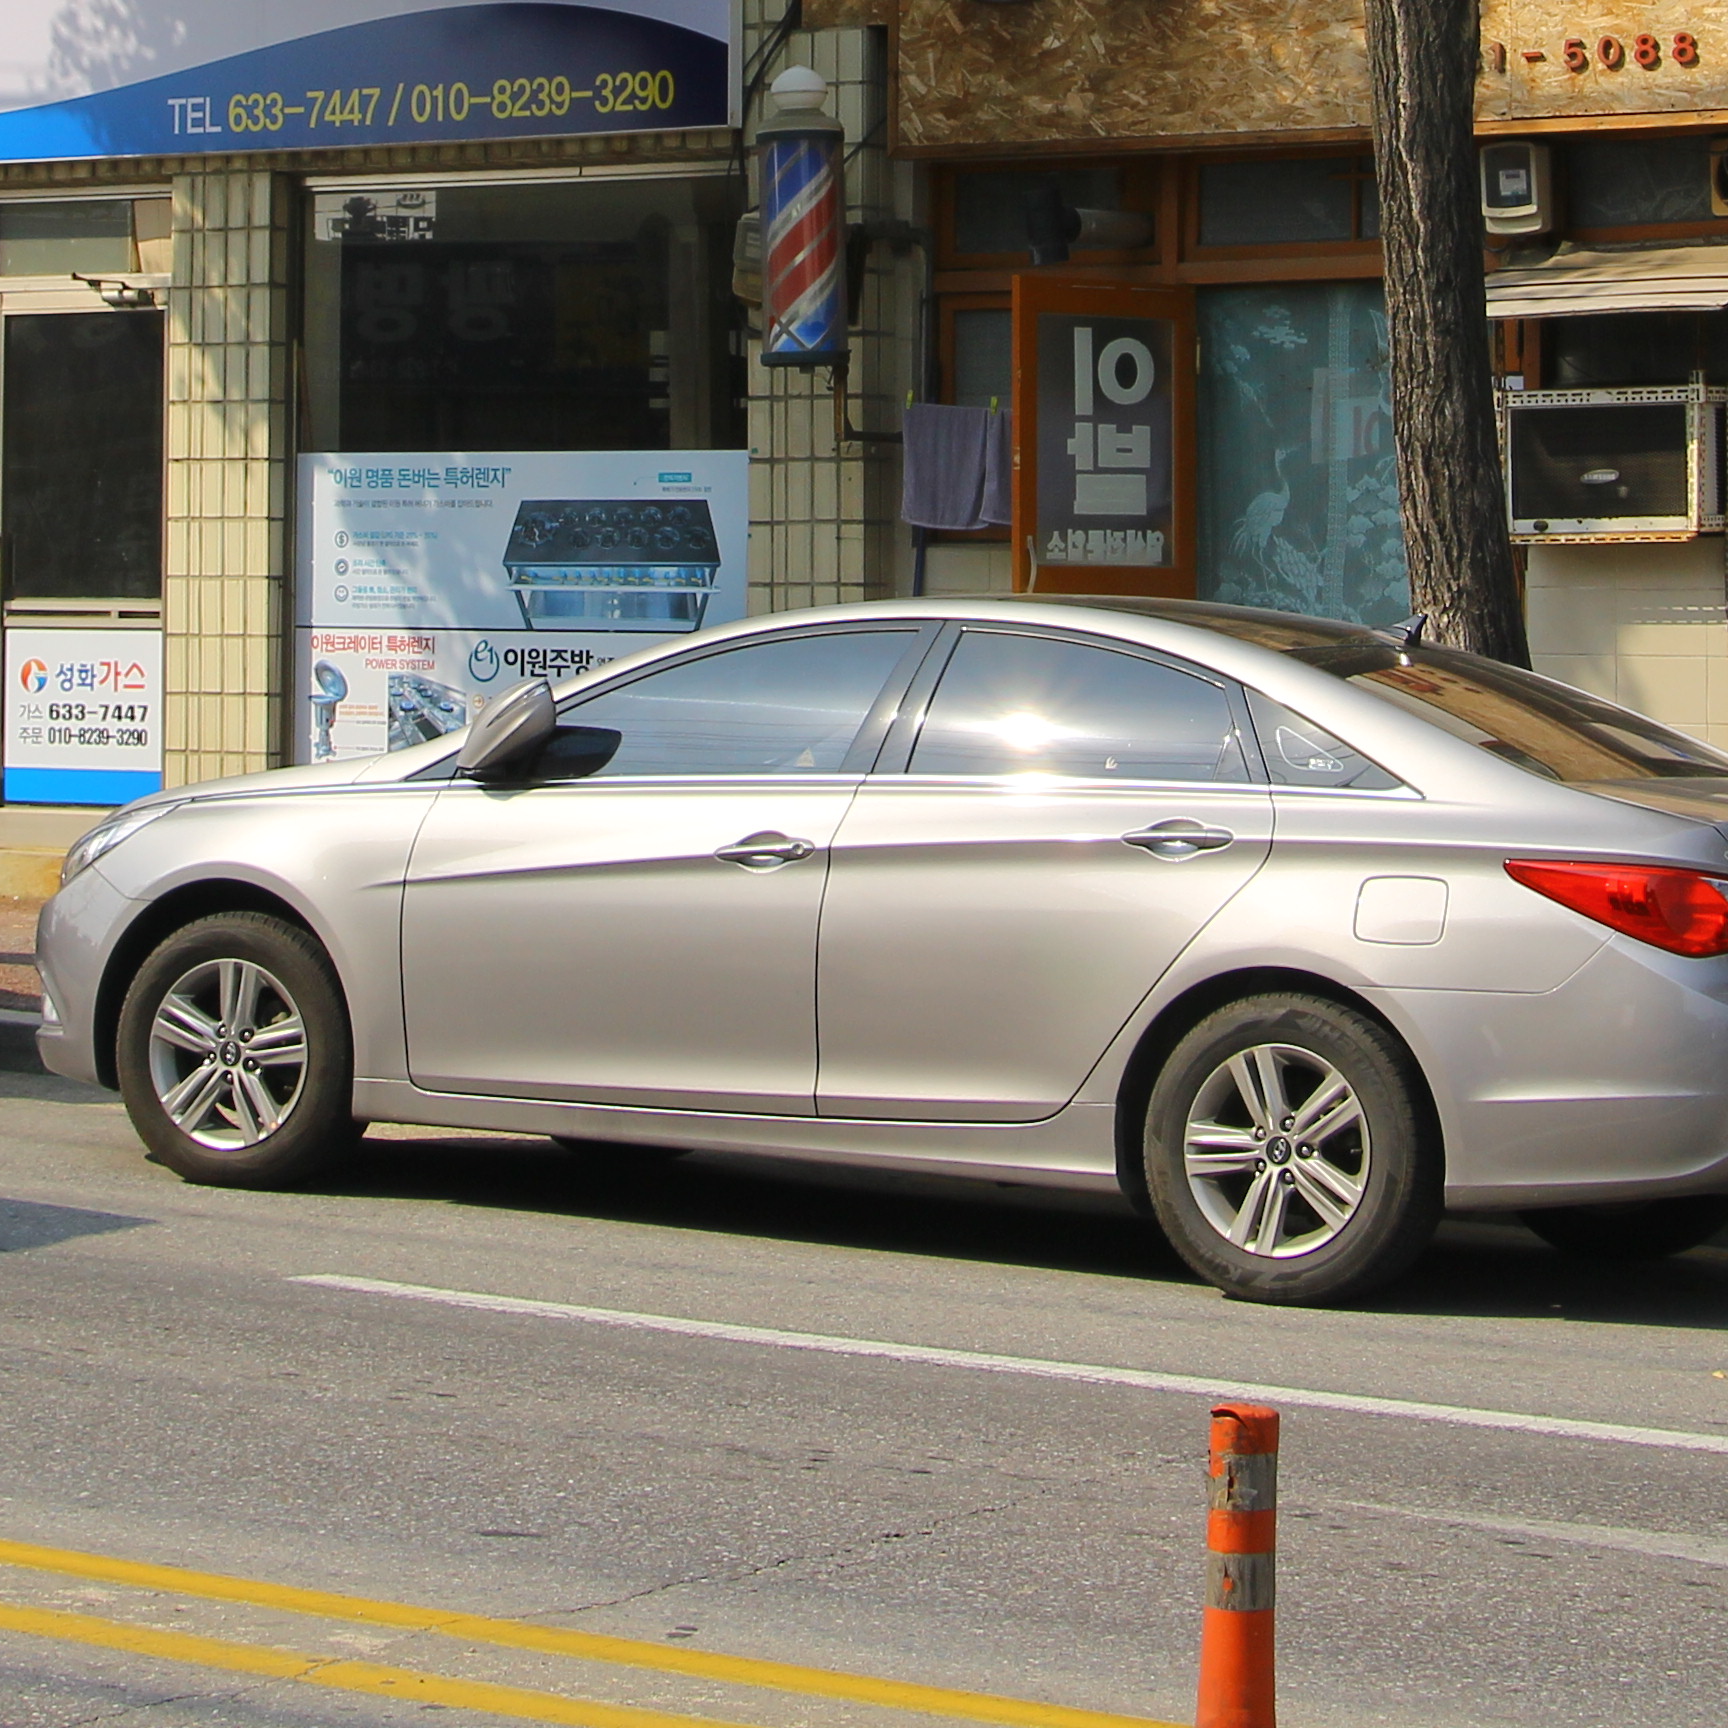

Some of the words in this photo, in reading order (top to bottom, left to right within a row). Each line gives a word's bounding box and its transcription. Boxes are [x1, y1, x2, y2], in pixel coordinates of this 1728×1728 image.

[167, 97, 222, 134] TEL
[228, 87, 381, 133] 633-7447
[411, 69, 674, 123] 010-8239-3290
[366, 468, 394, 488] 명품
[397, 467, 441, 488] 돈버는
[311, 634, 383, 654] 이원크레이터
[386, 634, 435, 655] 특허렌지
[365, 659, 398, 670] POWER
[399, 659, 435, 670] SYSTEM
[503, 648, 594, 677] 이원주방
[55, 660, 146, 693] 성화가스
[19, 703, 43, 721] 가스
[49, 703, 149, 722] 633-7447
[19, 726, 43, 745] 주문
[48, 726, 148, 747] 010-8239-3290
